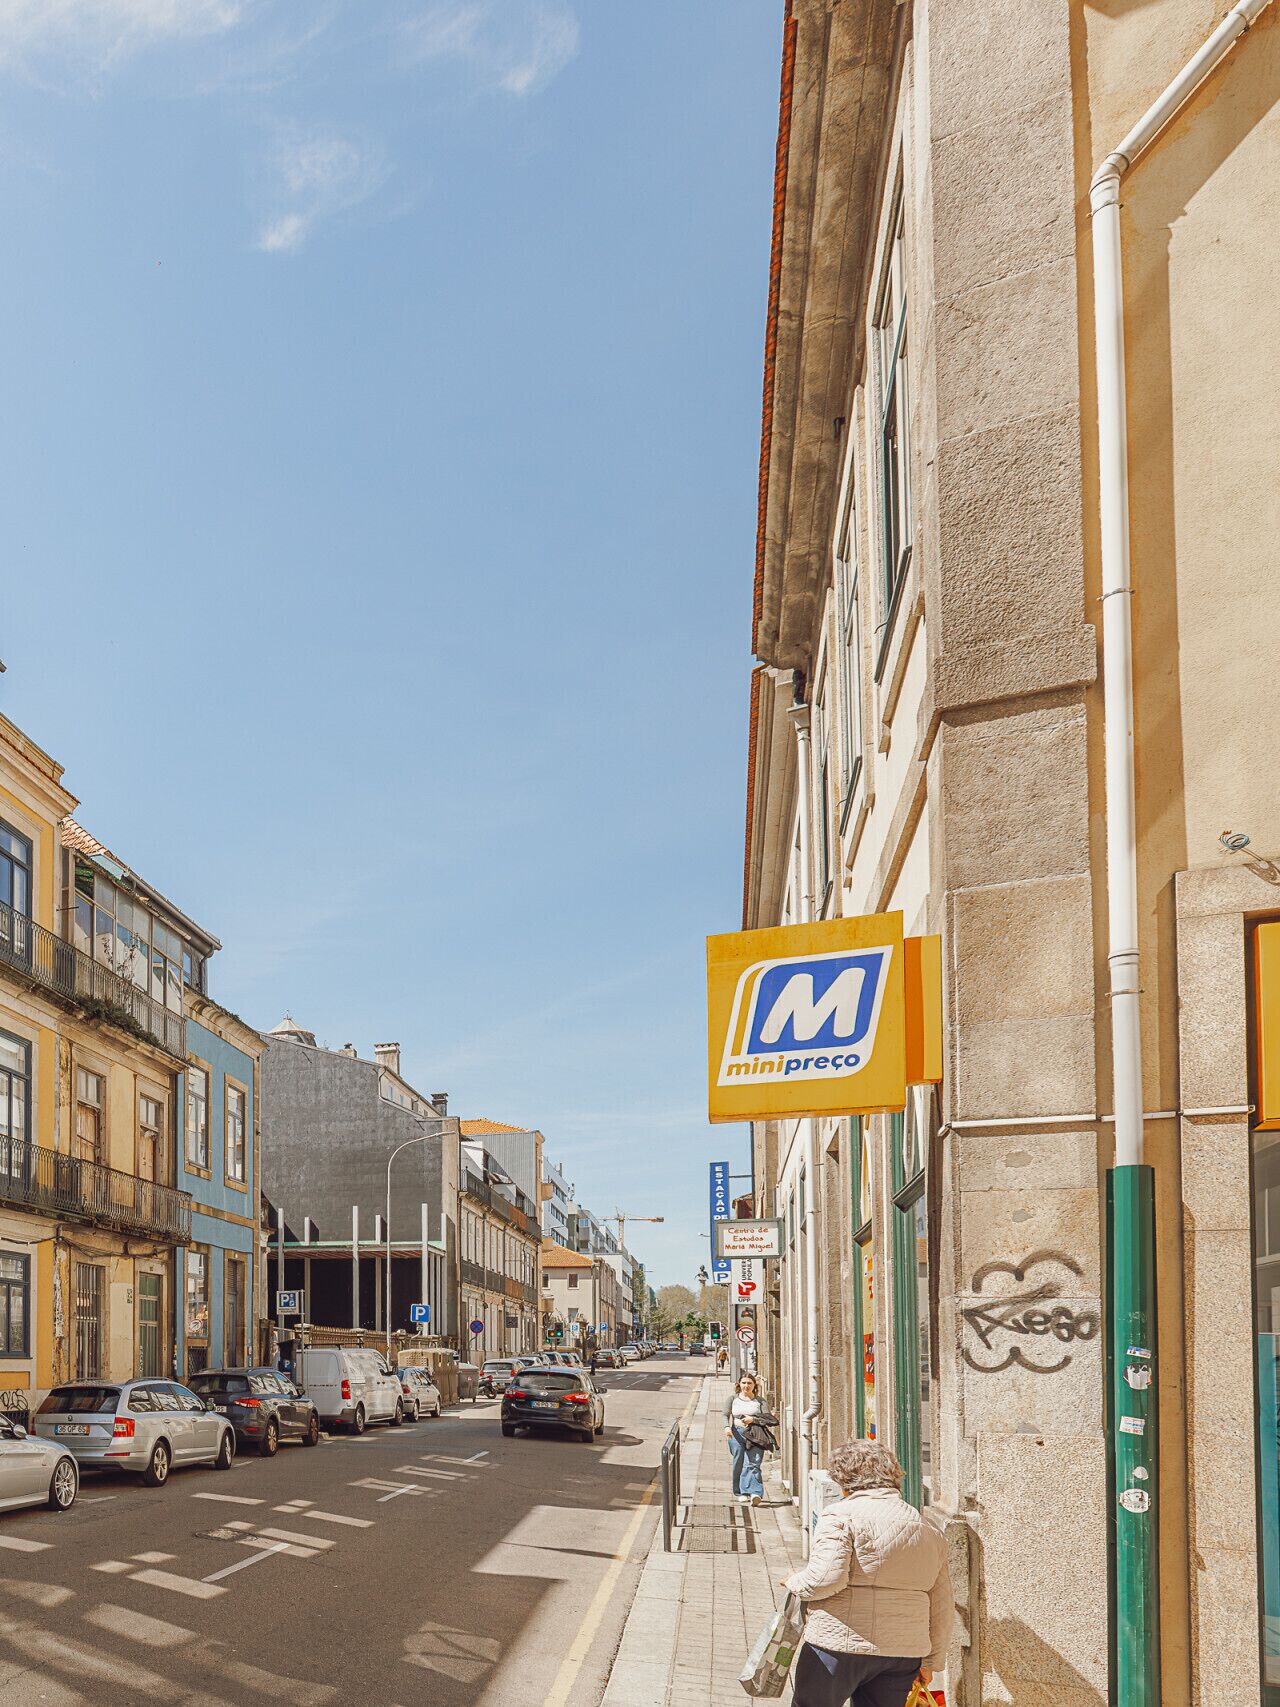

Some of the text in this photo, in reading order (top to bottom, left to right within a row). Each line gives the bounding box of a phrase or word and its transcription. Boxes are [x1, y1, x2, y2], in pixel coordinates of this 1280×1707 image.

[759, 967, 866, 1044] M
[726, 1053, 860, 1076] minipreço
[748, 1242, 773, 1252] Miguel
[717, 1273, 728, 1282] P
[280, 1294, 289, 1306] P
[415, 1306, 426, 1320] P
